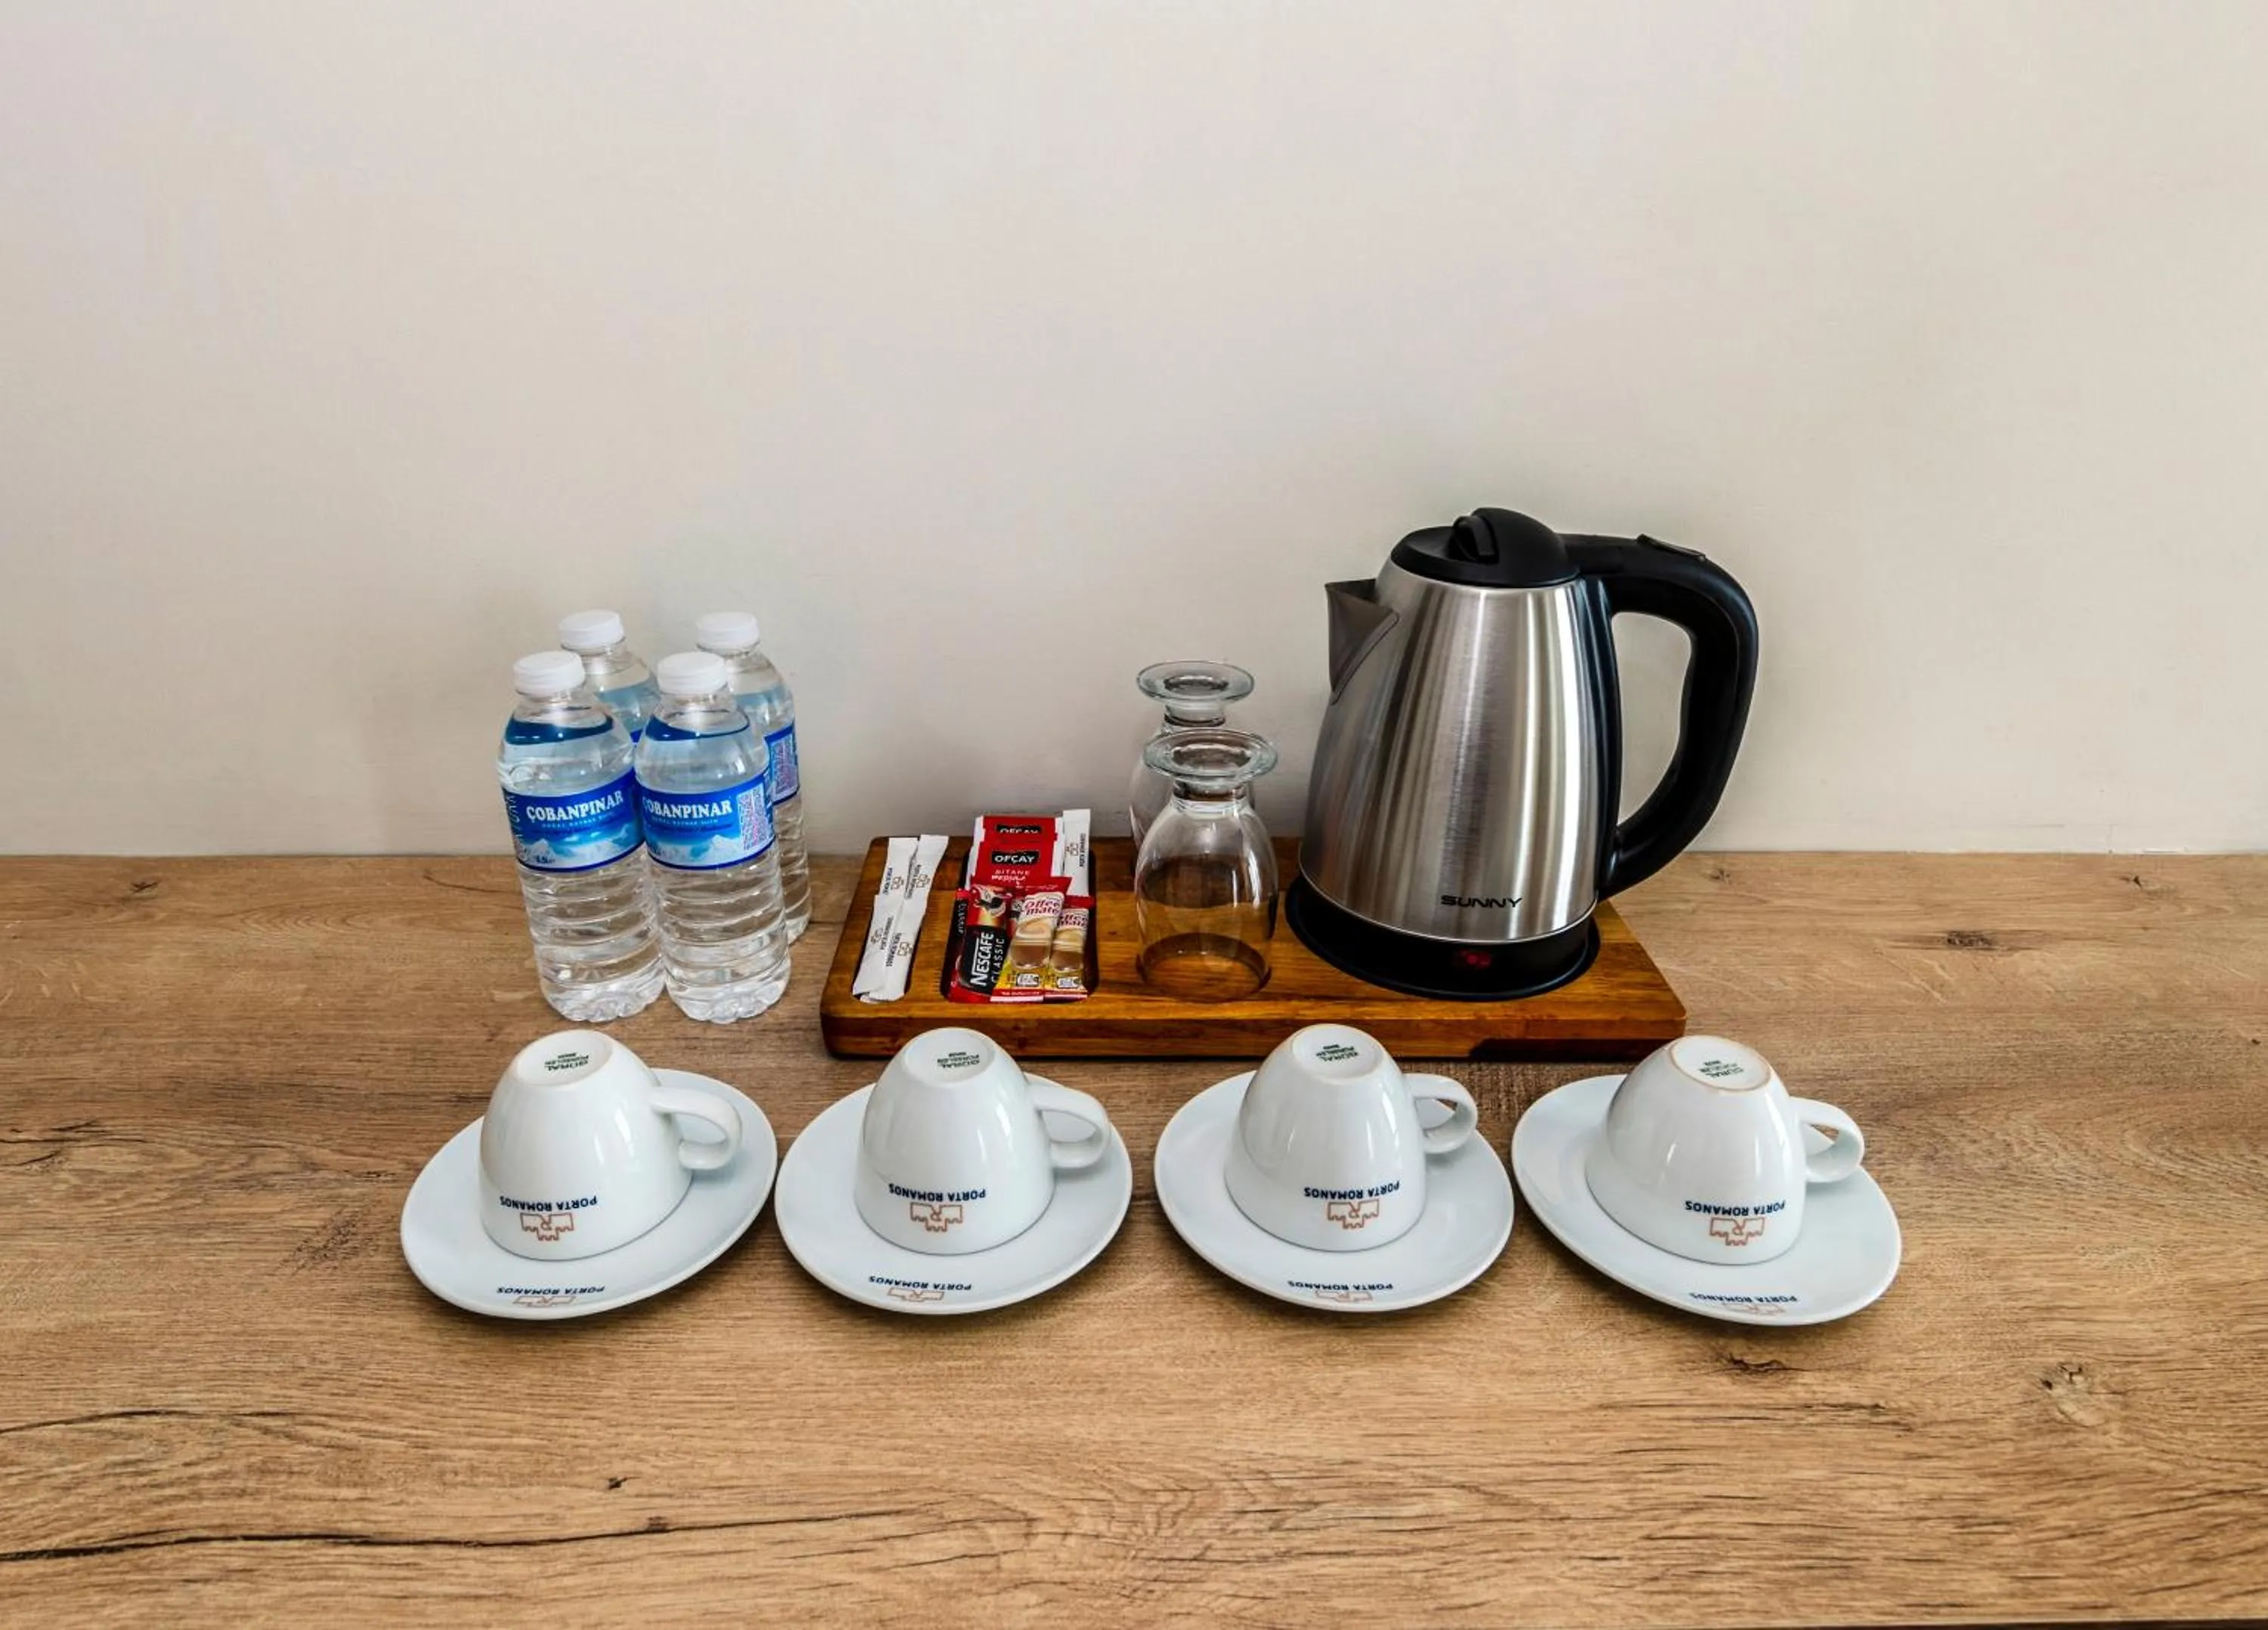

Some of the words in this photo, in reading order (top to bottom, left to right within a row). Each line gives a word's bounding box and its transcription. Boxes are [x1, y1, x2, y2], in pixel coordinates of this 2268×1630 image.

[525, 790, 624, 823] ÇOBANPINAR
[994, 855, 1036, 864] OFÇAY
[1441, 894, 1523, 908] SUNNY
[888, 1183, 943, 1202] ROMANOS
[947, 1189, 987, 1202] PORTA
[1303, 1187, 1364, 1200] ROMANOS
[1368, 1180, 1400, 1198] PORTA
[499, 1196, 553, 1211] ROMANOS
[556, 1195, 598, 1210] PORTA
[1684, 1201, 1749, 1216] ROMANOS
[1753, 1200, 1786, 1215] PORTA
[868, 1275, 929, 1289] ROMANOS
[1287, 1280, 1349, 1291] ROMANOS
[496, 1287, 560, 1295] ROMANOS
[564, 1286, 606, 1295] PORTA
